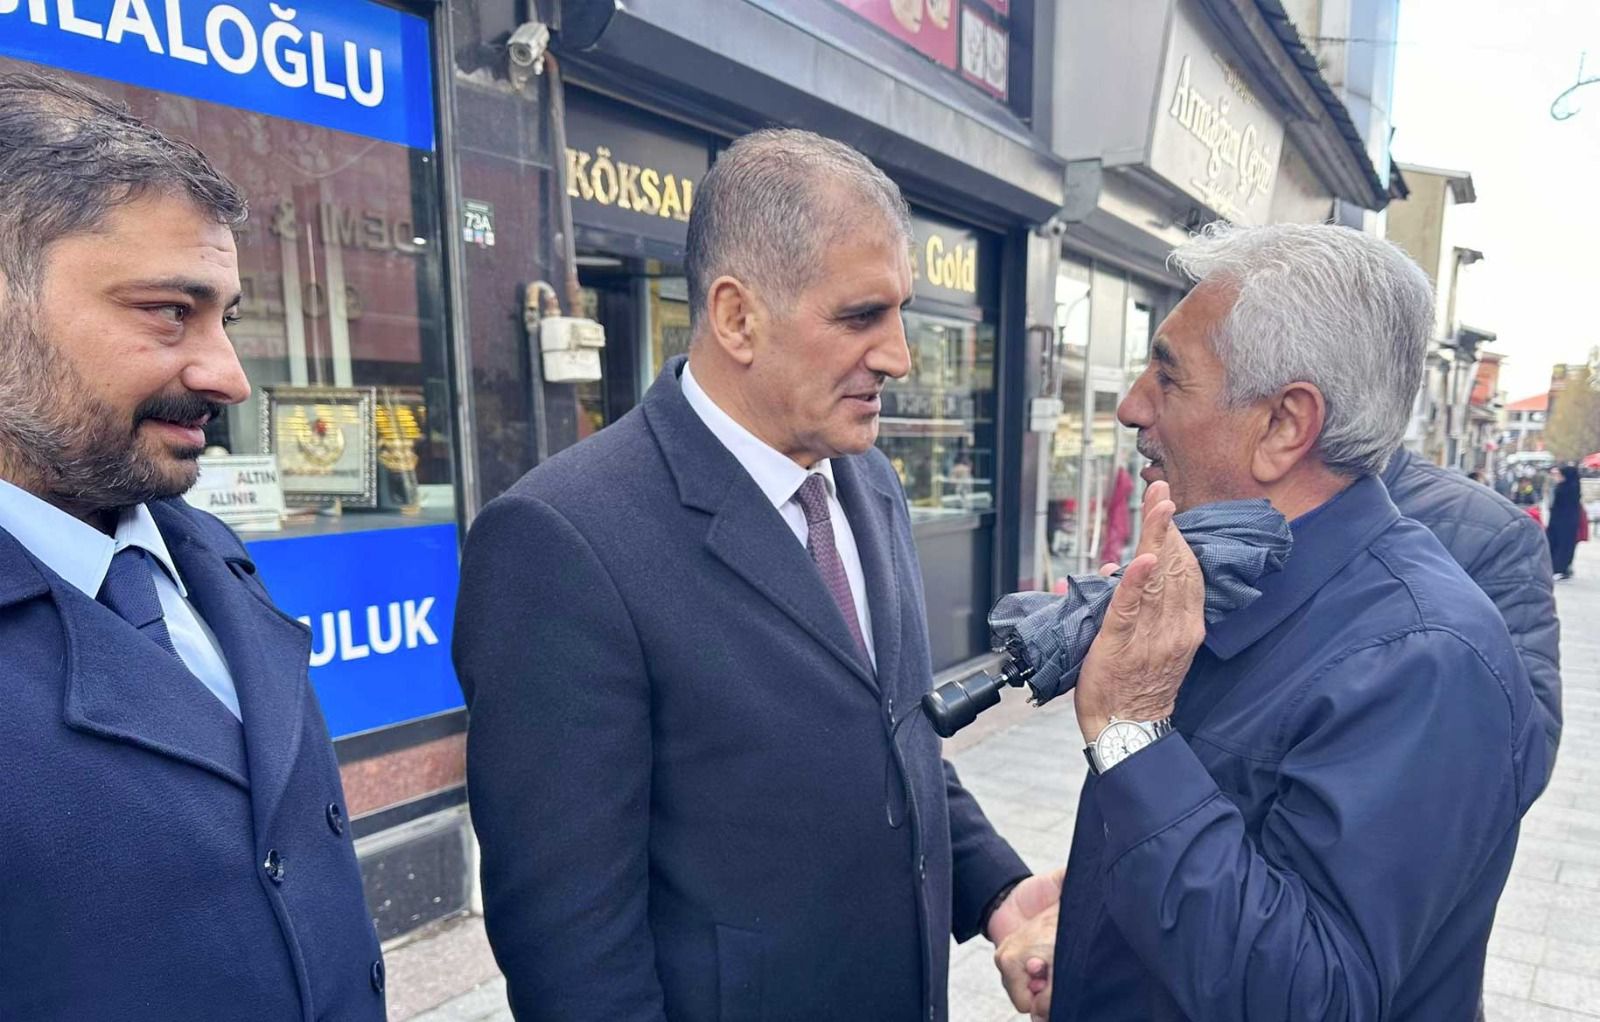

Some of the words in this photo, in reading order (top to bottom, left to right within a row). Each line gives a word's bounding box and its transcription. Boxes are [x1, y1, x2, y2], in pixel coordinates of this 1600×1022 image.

[0, 0, 384, 107] LALOĞLU
[926, 233, 976, 293] Gold
[237, 470, 277, 485] ALTIN
[209, 491, 257, 506] ALINIR
